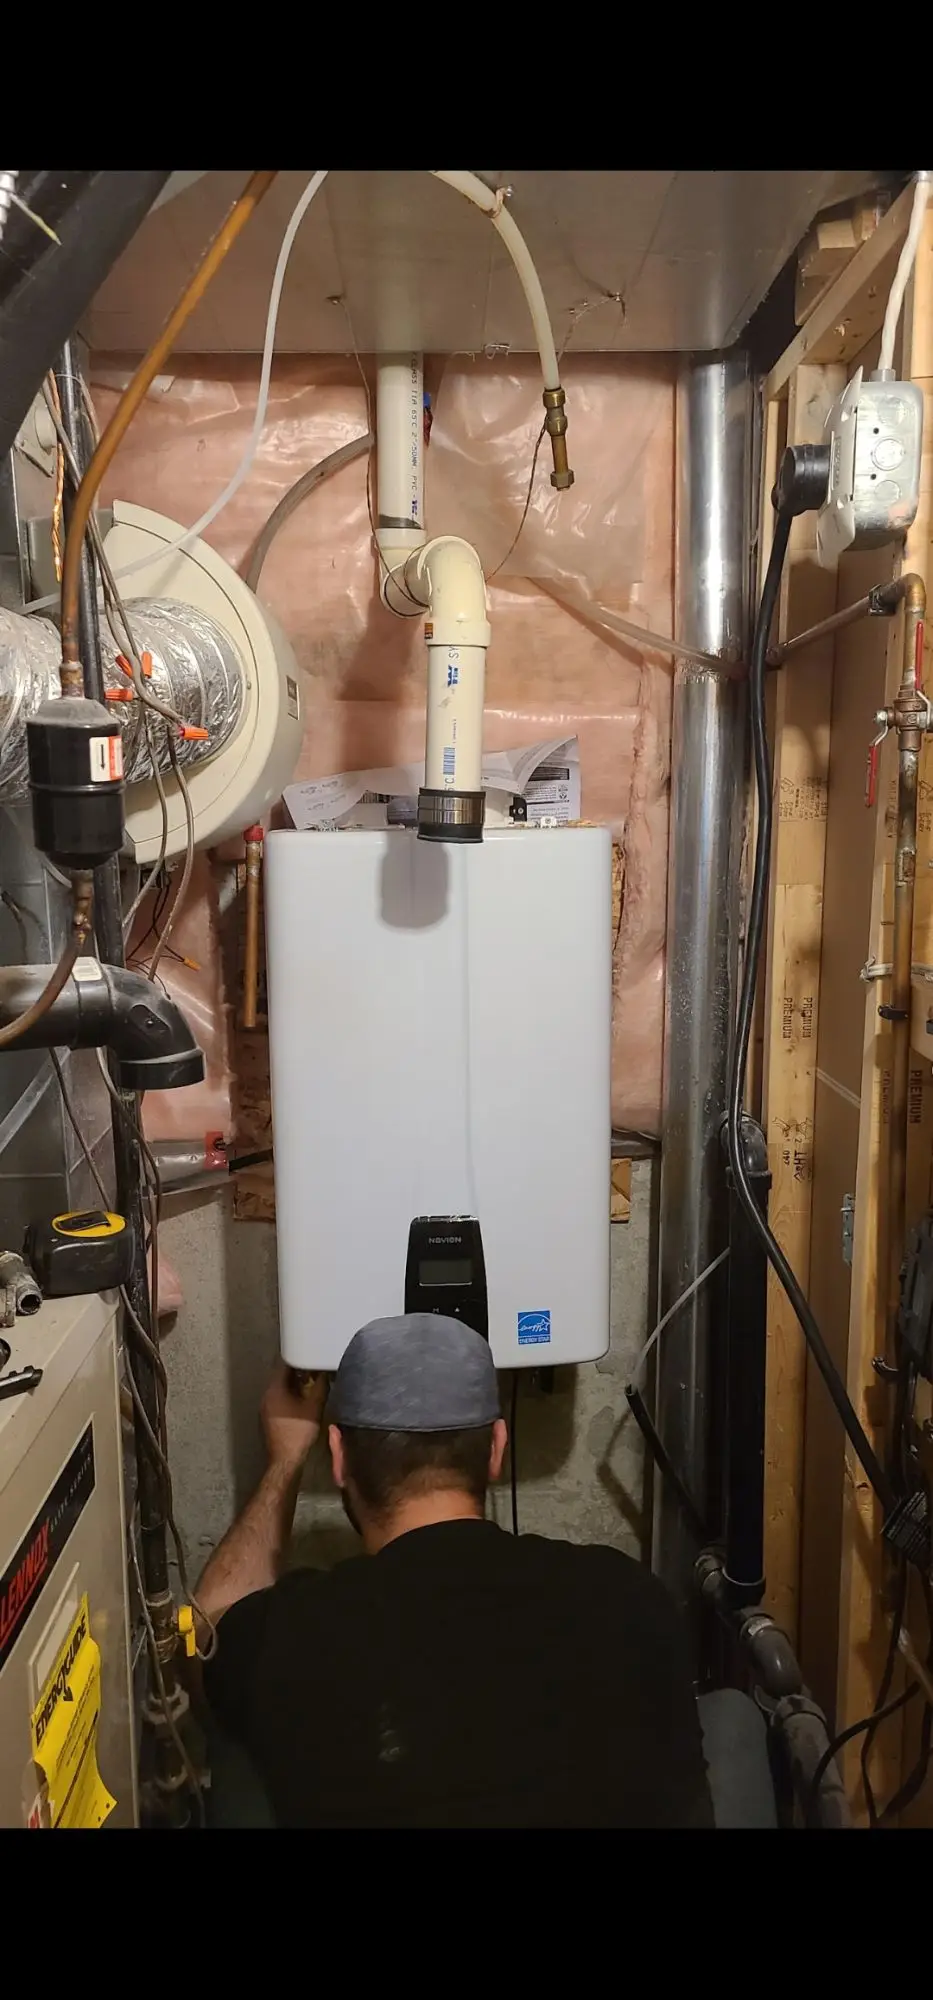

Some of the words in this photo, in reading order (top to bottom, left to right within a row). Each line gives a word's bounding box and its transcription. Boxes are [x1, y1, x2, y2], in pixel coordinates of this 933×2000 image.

[782, 997, 793, 1039] PREMIUM
[803, 996, 813, 1039] PREMIUM
[910, 1070, 922, 1124] PREMIUM
[0, 1521, 50, 1632] LENNOX
